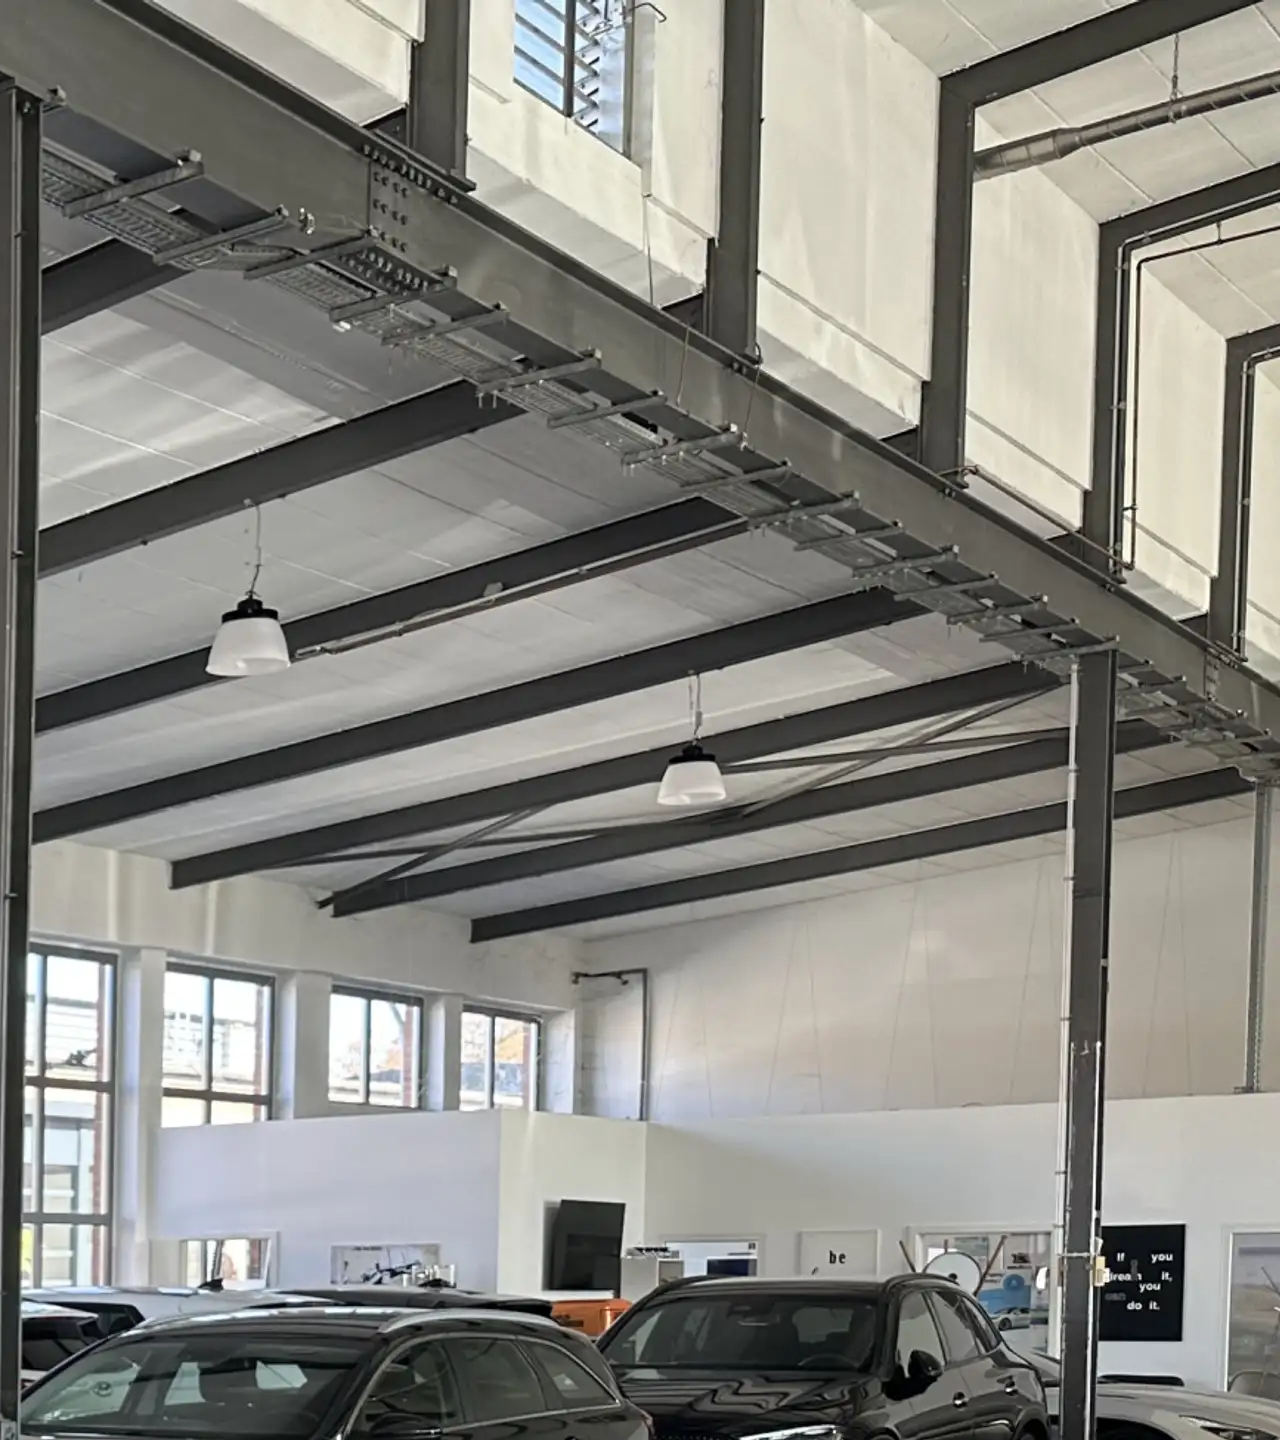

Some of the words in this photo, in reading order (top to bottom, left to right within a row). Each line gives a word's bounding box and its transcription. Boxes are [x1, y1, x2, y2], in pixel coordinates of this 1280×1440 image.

[829, 1250, 846, 1264] be
[1151, 1253, 1174, 1264] you
[1139, 1283, 1161, 1293] you
[1126, 1301, 1143, 1311] do
[1149, 1301, 1161, 1311] it.
